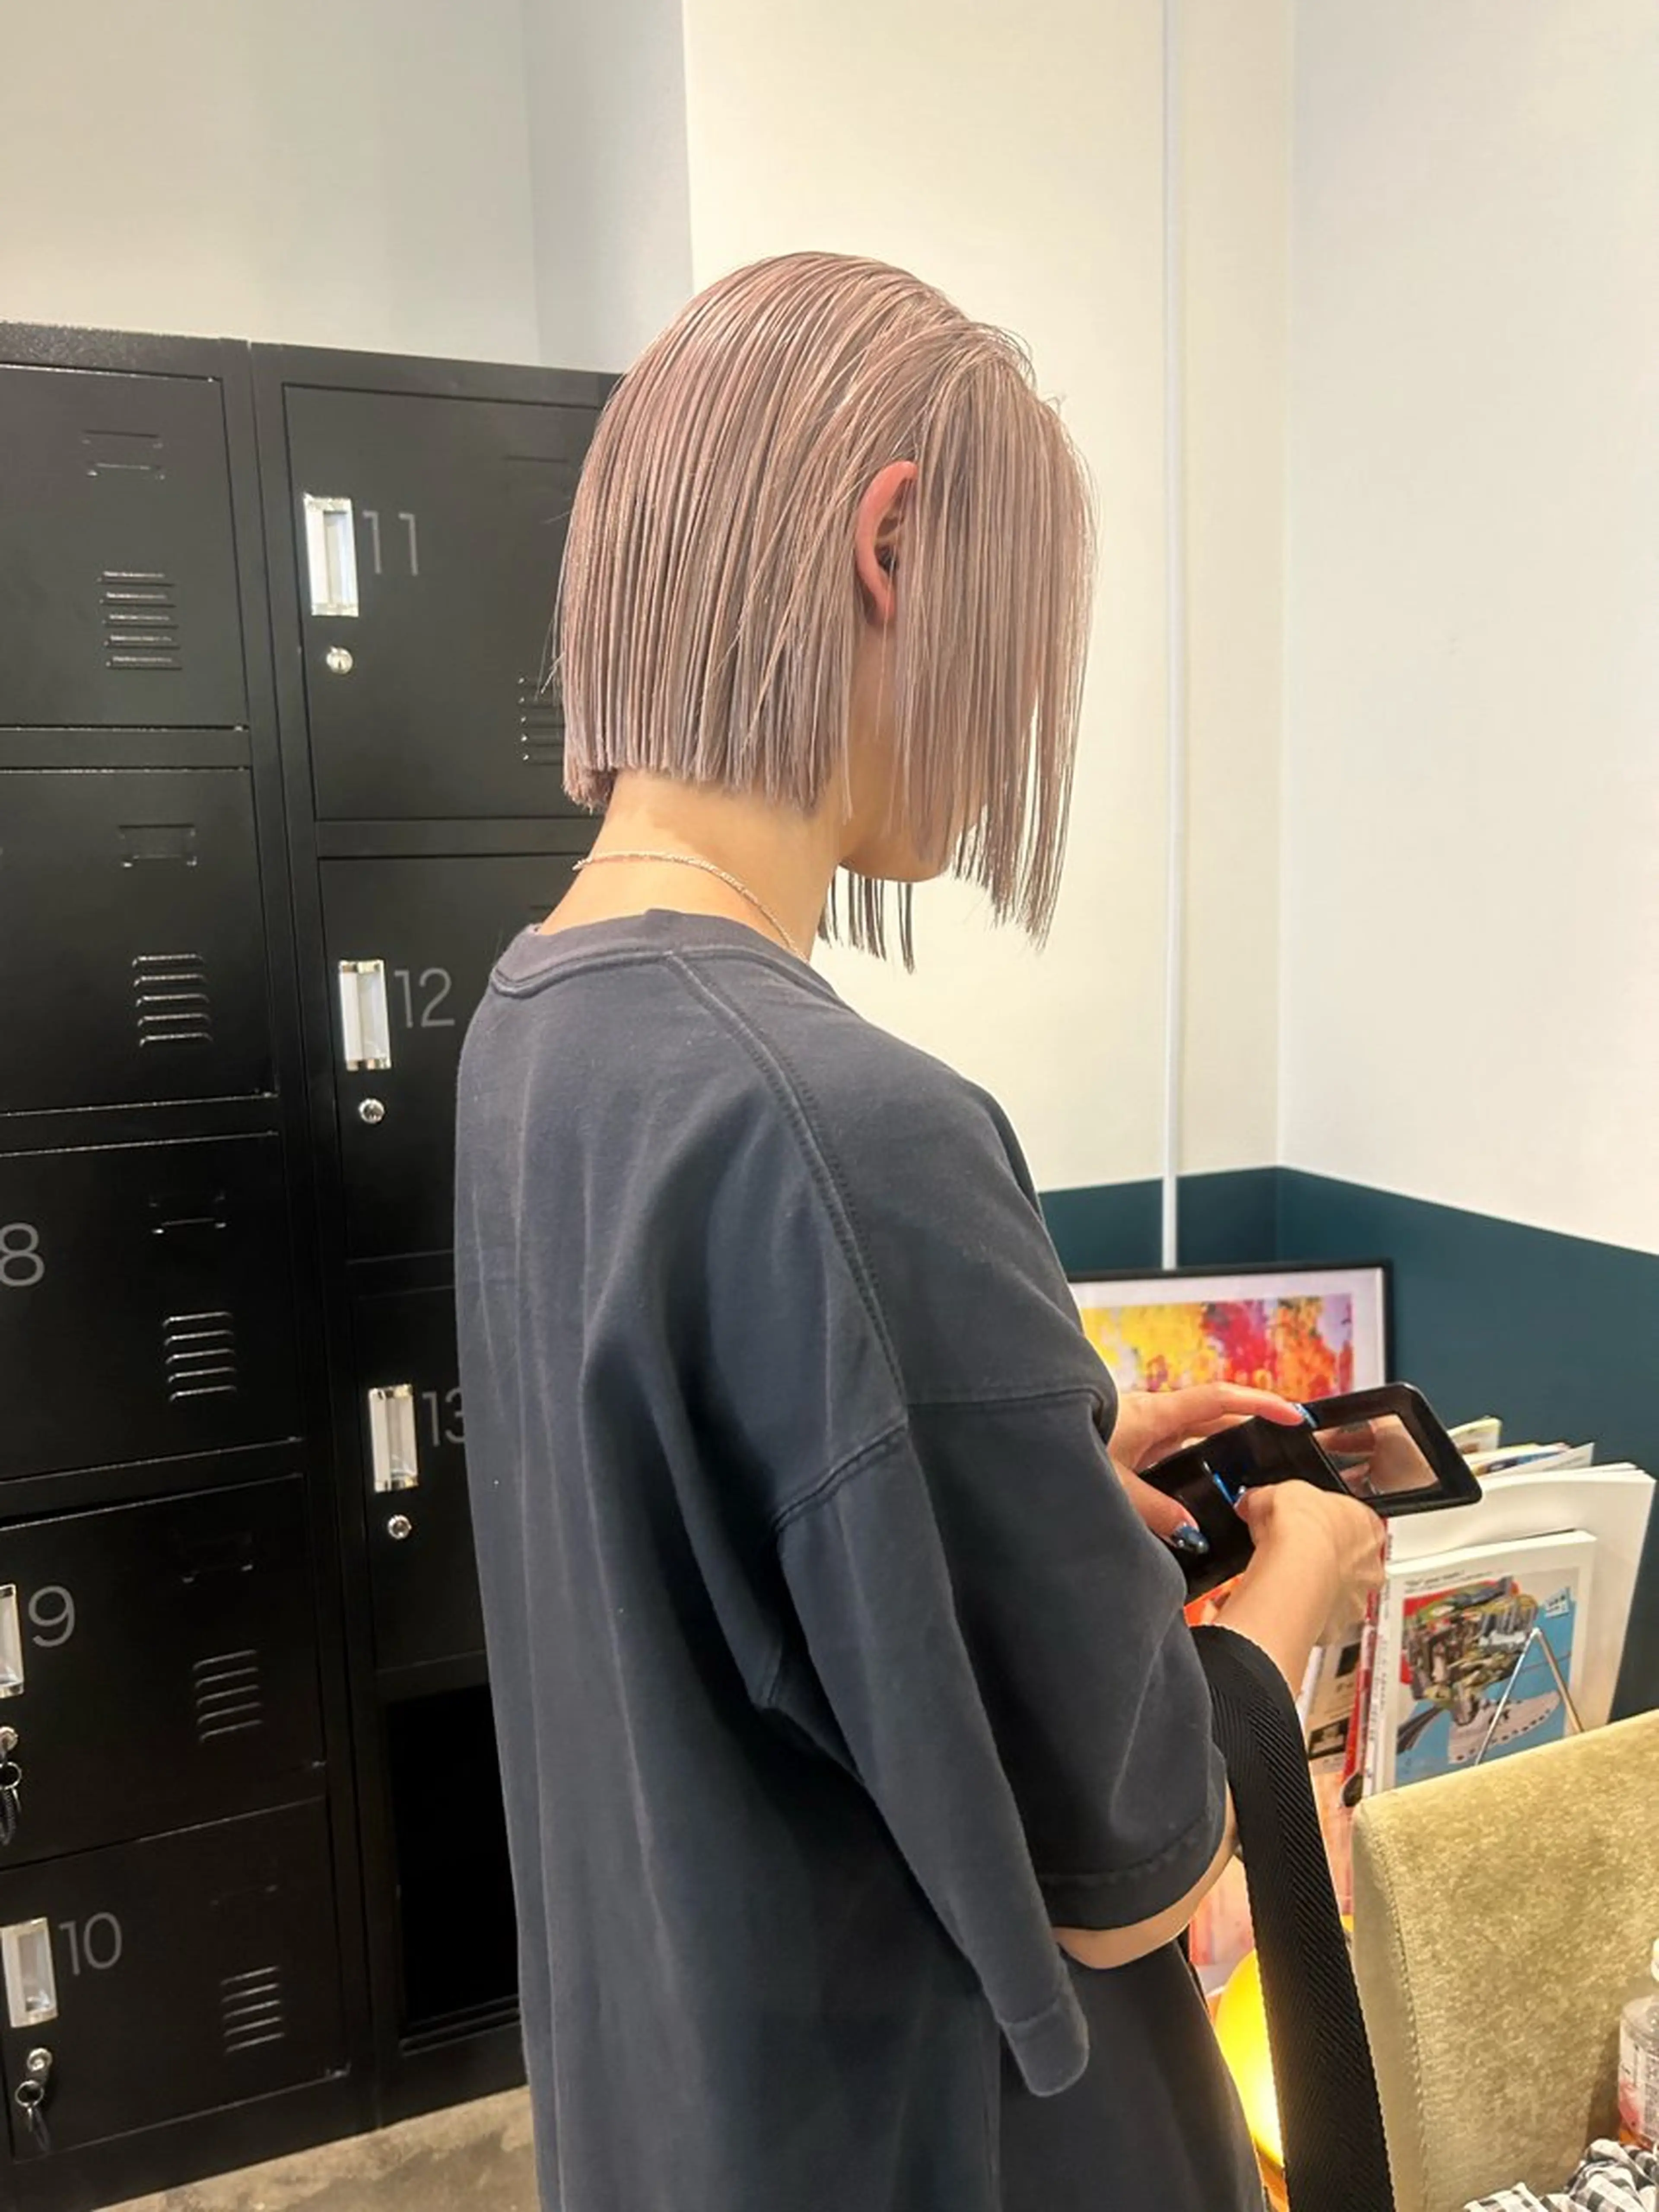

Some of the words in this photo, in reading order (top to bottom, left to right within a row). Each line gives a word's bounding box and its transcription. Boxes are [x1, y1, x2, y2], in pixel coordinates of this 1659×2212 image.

[362, 510, 418, 576] 11
[394, 967, 455, 1028] 12
[0, 1222, 45, 1287] 8
[422, 1387, 465, 1447] 13
[29, 1586, 75, 1648] 9
[58, 1912, 122, 1975] 10
